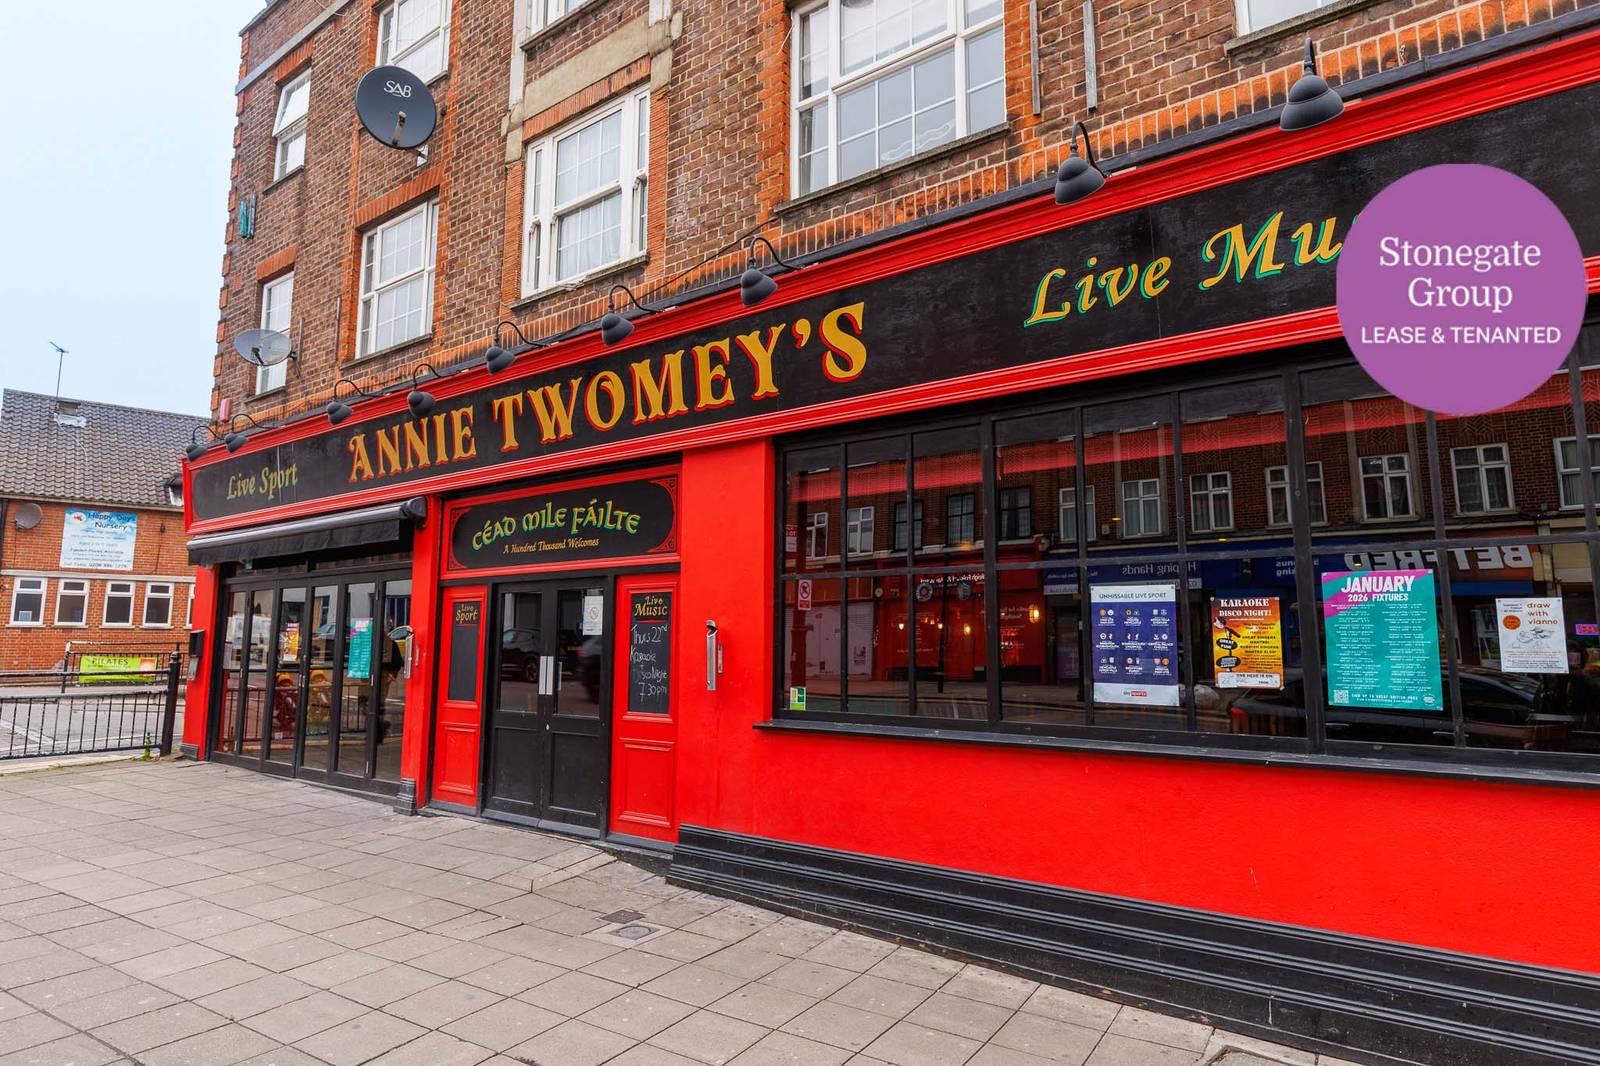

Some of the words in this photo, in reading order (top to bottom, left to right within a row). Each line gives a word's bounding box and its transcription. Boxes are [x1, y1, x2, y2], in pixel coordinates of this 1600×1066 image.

[383, 80, 412, 98] SAB
[1023, 256, 1172, 329] Live
[1198, 210, 1359, 292] Mu
[346, 404, 478, 484] ANNIE
[491, 300, 868, 453] TWOMEY'S
[226, 473, 256, 501] Live
[259, 462, 299, 501] Sport
[94, 521, 129, 533] Nursery
[503, 544, 510, 555] A
[511, 540, 537, 554] Hundred
[537, 538, 567, 551] Thousand
[568, 536, 600, 549] Welcomes
[1341, 575, 1416, 593] JANUARY
[645, 595, 663, 606] Live
[1220, 598, 1270, 607] KARAOKE
[1347, 593, 1369, 602] 2026
[1372, 593, 1409, 602] FIXTURES
[456, 609, 480, 625] Sport
[634, 603, 668, 617] Music
[1243, 609, 1272, 617] NIGHT!
[92, 657, 129, 666] PILATES
